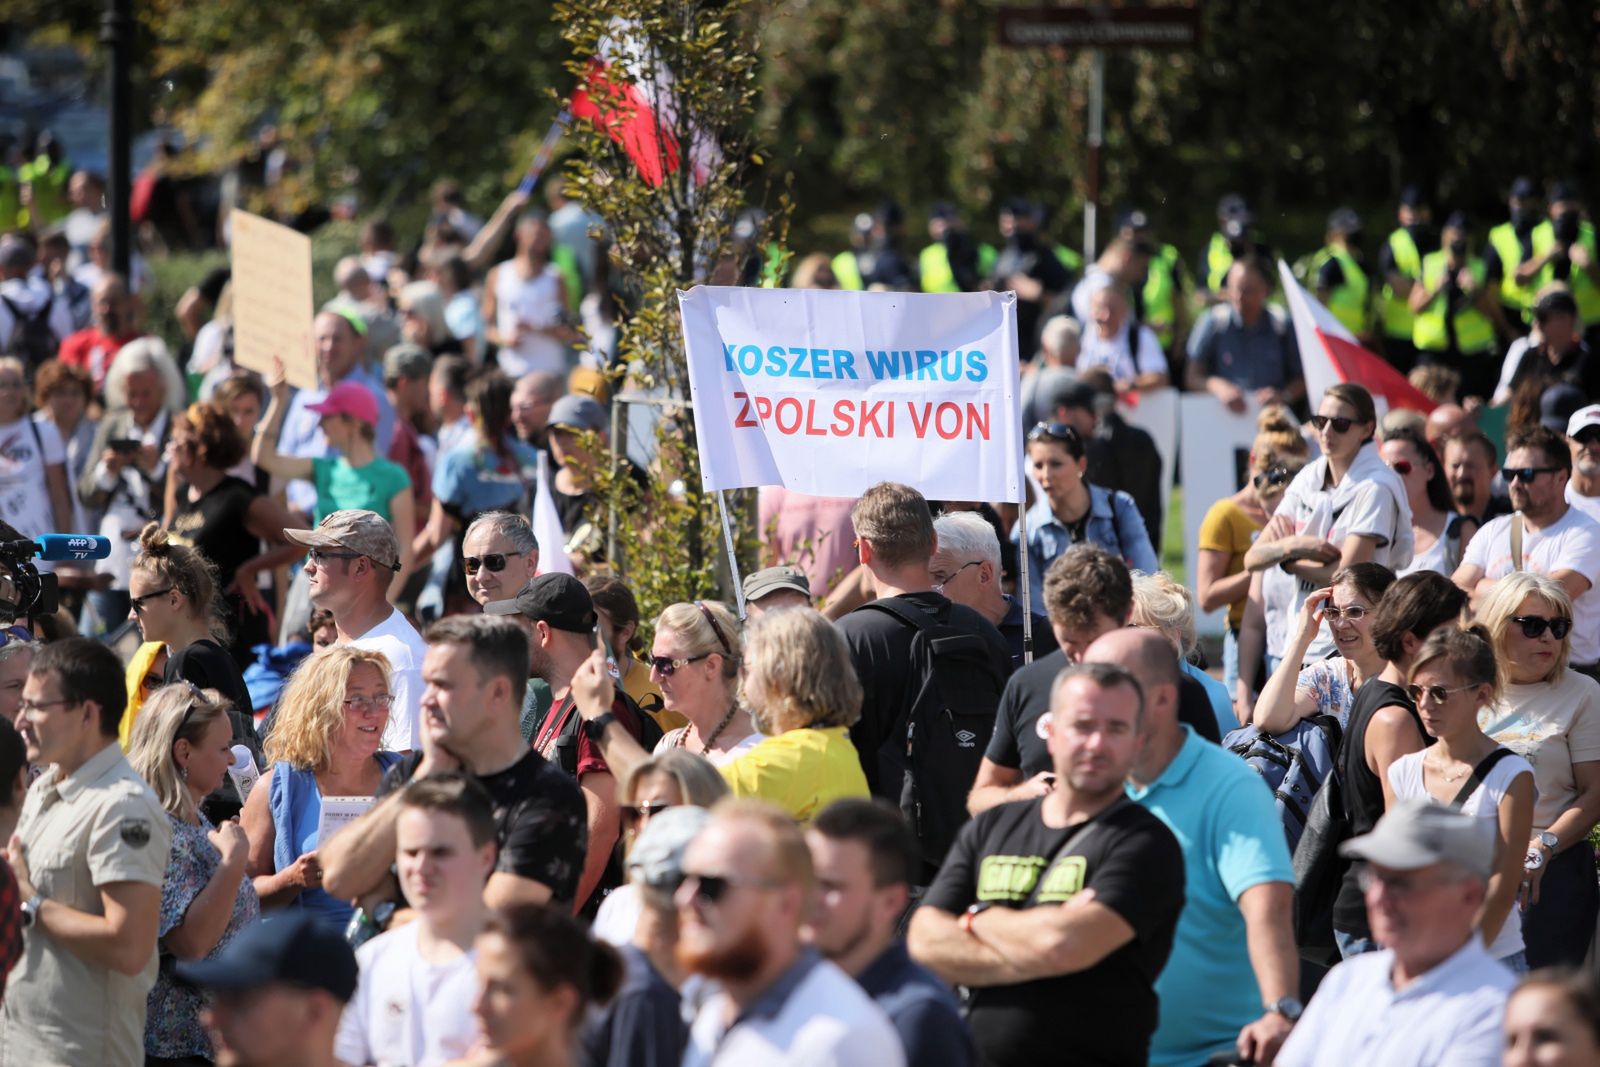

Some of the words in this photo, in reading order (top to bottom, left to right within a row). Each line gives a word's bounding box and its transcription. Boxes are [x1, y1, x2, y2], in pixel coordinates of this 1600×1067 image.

[722, 343, 858, 380] KOSZER
[866, 350, 989, 383] WIRUS
[908, 401, 991, 440] VON
[68, 538, 87, 547] AFP
